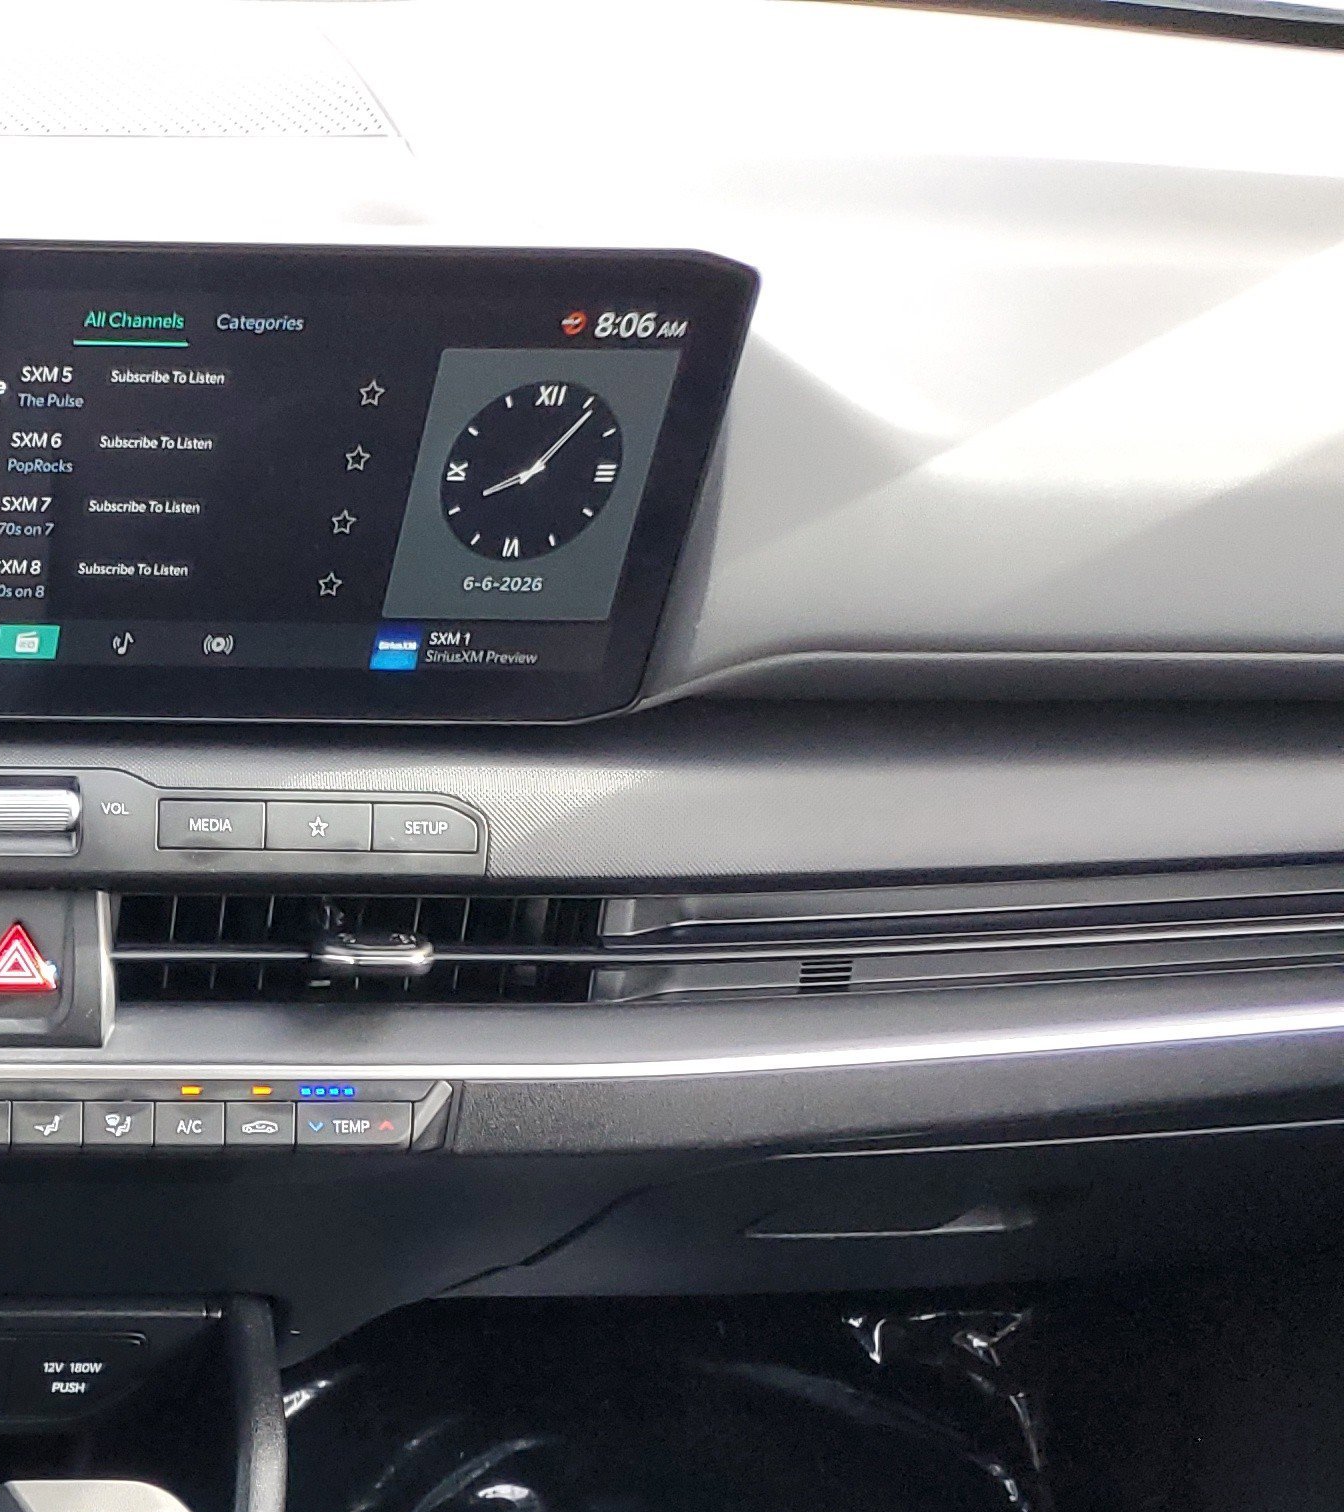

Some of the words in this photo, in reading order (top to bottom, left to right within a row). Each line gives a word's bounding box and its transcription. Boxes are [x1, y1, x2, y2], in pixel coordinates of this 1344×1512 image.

[83, 311, 107, 328] All
[108, 311, 184, 329] Channels
[216, 313, 304, 334] Categories
[594, 312, 657, 338] 8:06
[656, 321, 688, 338] AM
[21, 365, 59, 383] SXM
[61, 366, 73, 383] 5
[110, 369, 170, 384] Subscribe
[172, 370, 187, 384] To
[188, 371, 225, 385] Listen
[18, 392, 45, 407] The
[47, 393, 84, 408] Pulse
[10, 431, 48, 448] SXM
[50, 432, 62, 449] 6
[99, 435, 159, 449] Subscribe
[160, 436, 179, 449] To
[176, 437, 213, 450] Listen
[7, 458, 73, 475] PopRocks
[0, 496, 38, 513] SXM
[40, 496, 52, 513] 7
[88, 499, 147, 513] Subscribe
[148, 500, 168, 513] To
[164, 501, 201, 514] Listen
[23, 525, 42, 536] on
[45, 522, 55, 536] 7
[29, 559, 42, 575] 8
[77, 562, 135, 575] Subscribe
[137, 563, 156, 576] To
[153, 563, 189, 577] Listen
[463, 576, 543, 592] 6-6-2026
[14, 587, 33, 598] on
[34, 585, 45, 599] 8
[429, 631, 461, 646] SXM
[464, 632, 471, 646] 1
[425, 649, 484, 663] SiriusXM
[485, 650, 538, 664] Preview
[100, 802, 130, 815] VOL
[189, 818, 233, 832] MEDIA
[404, 820, 448, 835] SETUP
[176, 1119, 202, 1135] A/C
[332, 1119, 371, 1134] TEMP
[43, 1362, 65, 1373] 12V
[69, 1362, 103, 1374] 180W
[51, 1381, 86, 1394] PUSH
